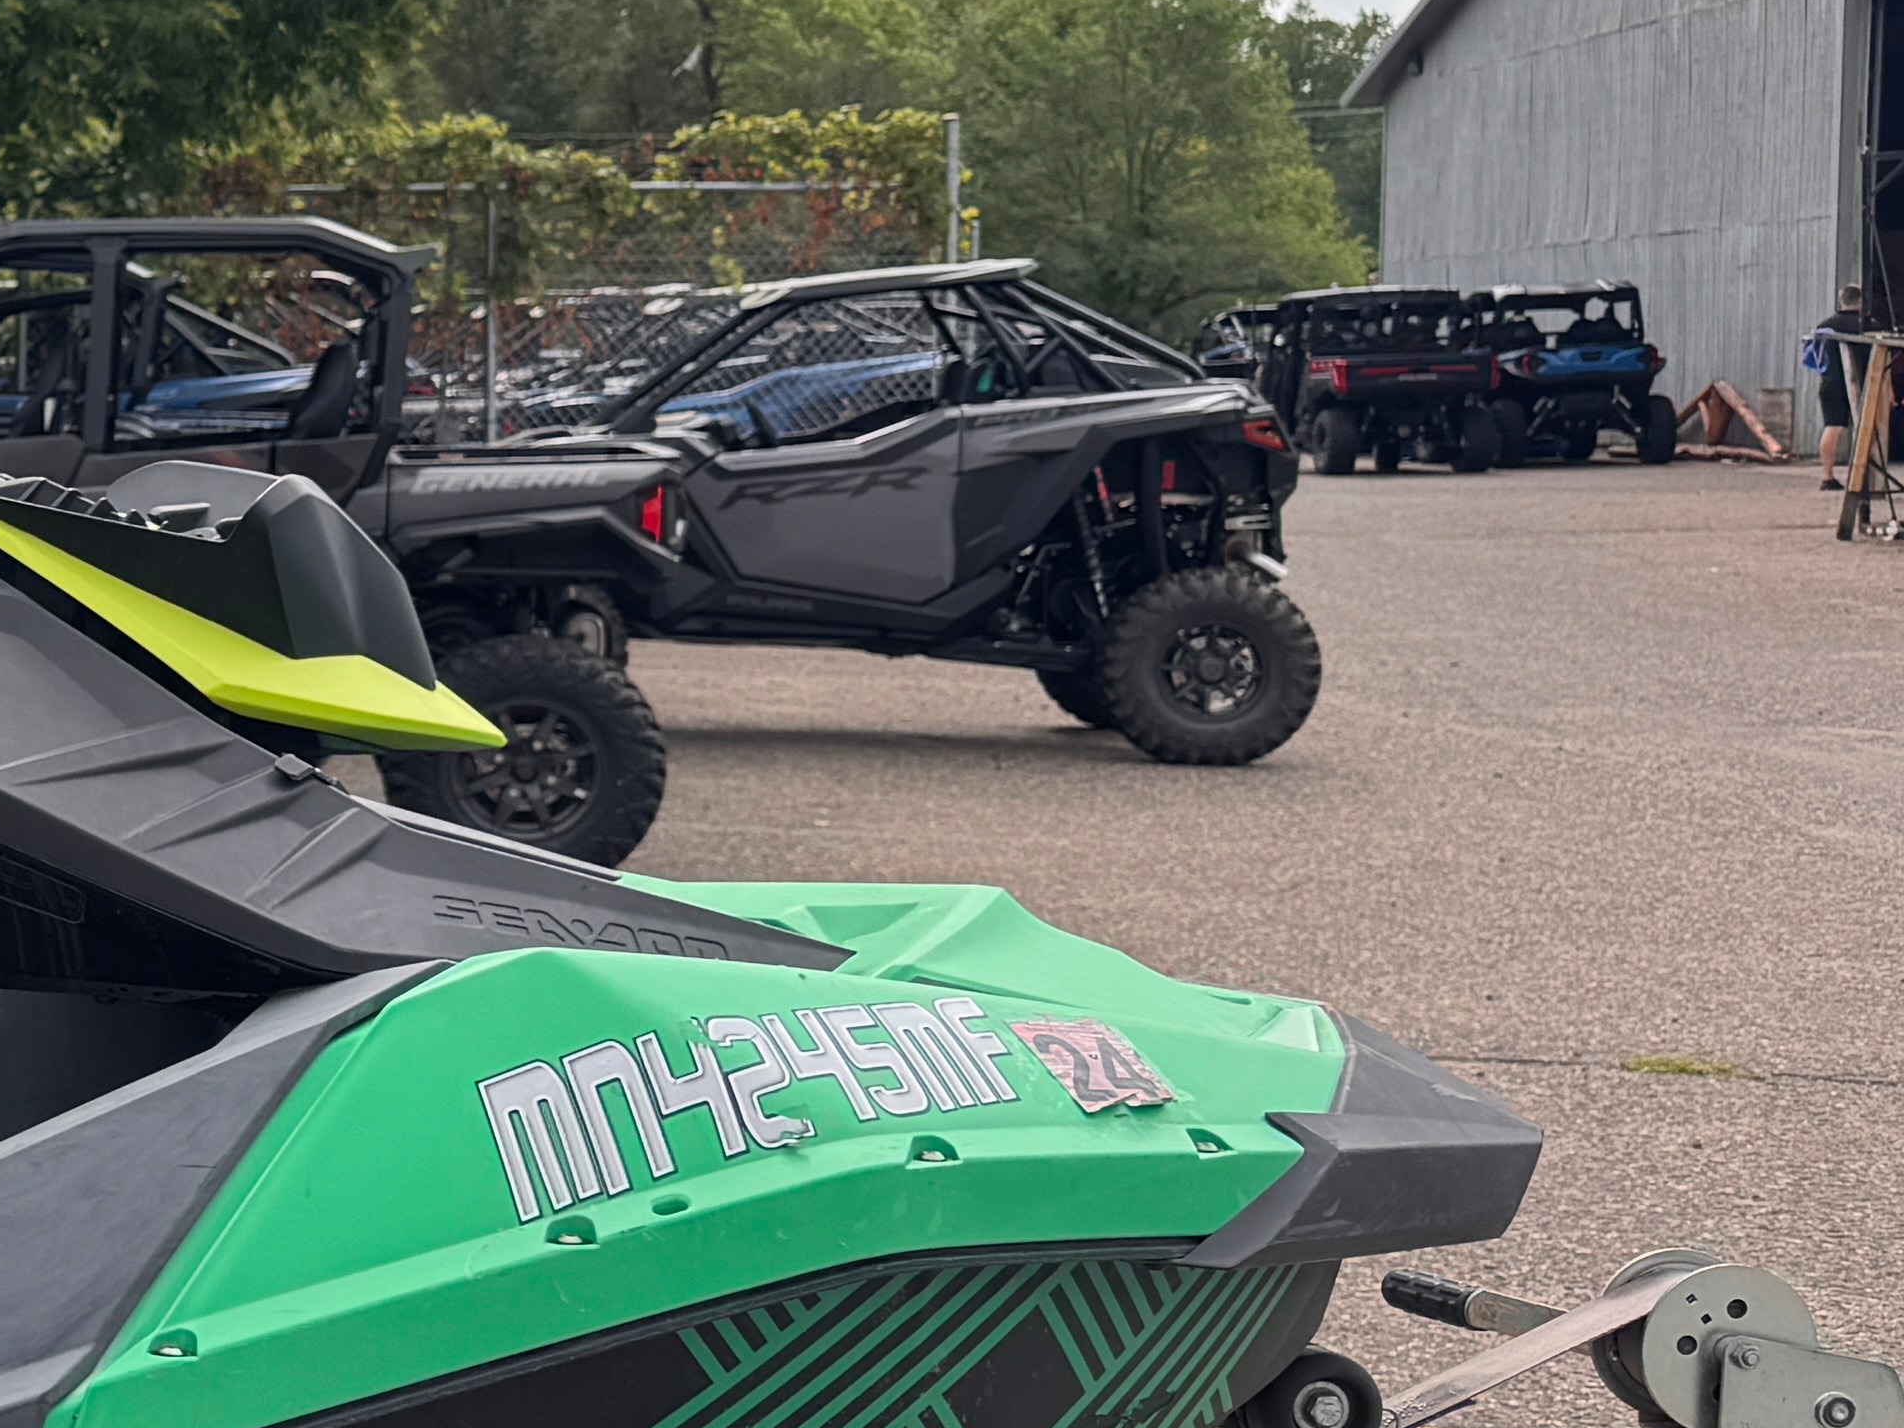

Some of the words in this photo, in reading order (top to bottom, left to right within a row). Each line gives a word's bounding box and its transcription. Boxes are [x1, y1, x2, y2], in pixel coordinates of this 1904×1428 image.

[718, 466, 929, 510] RZR
[1030, 1030, 1162, 1104] 24
[478, 995, 1018, 1224] MN4245MF
